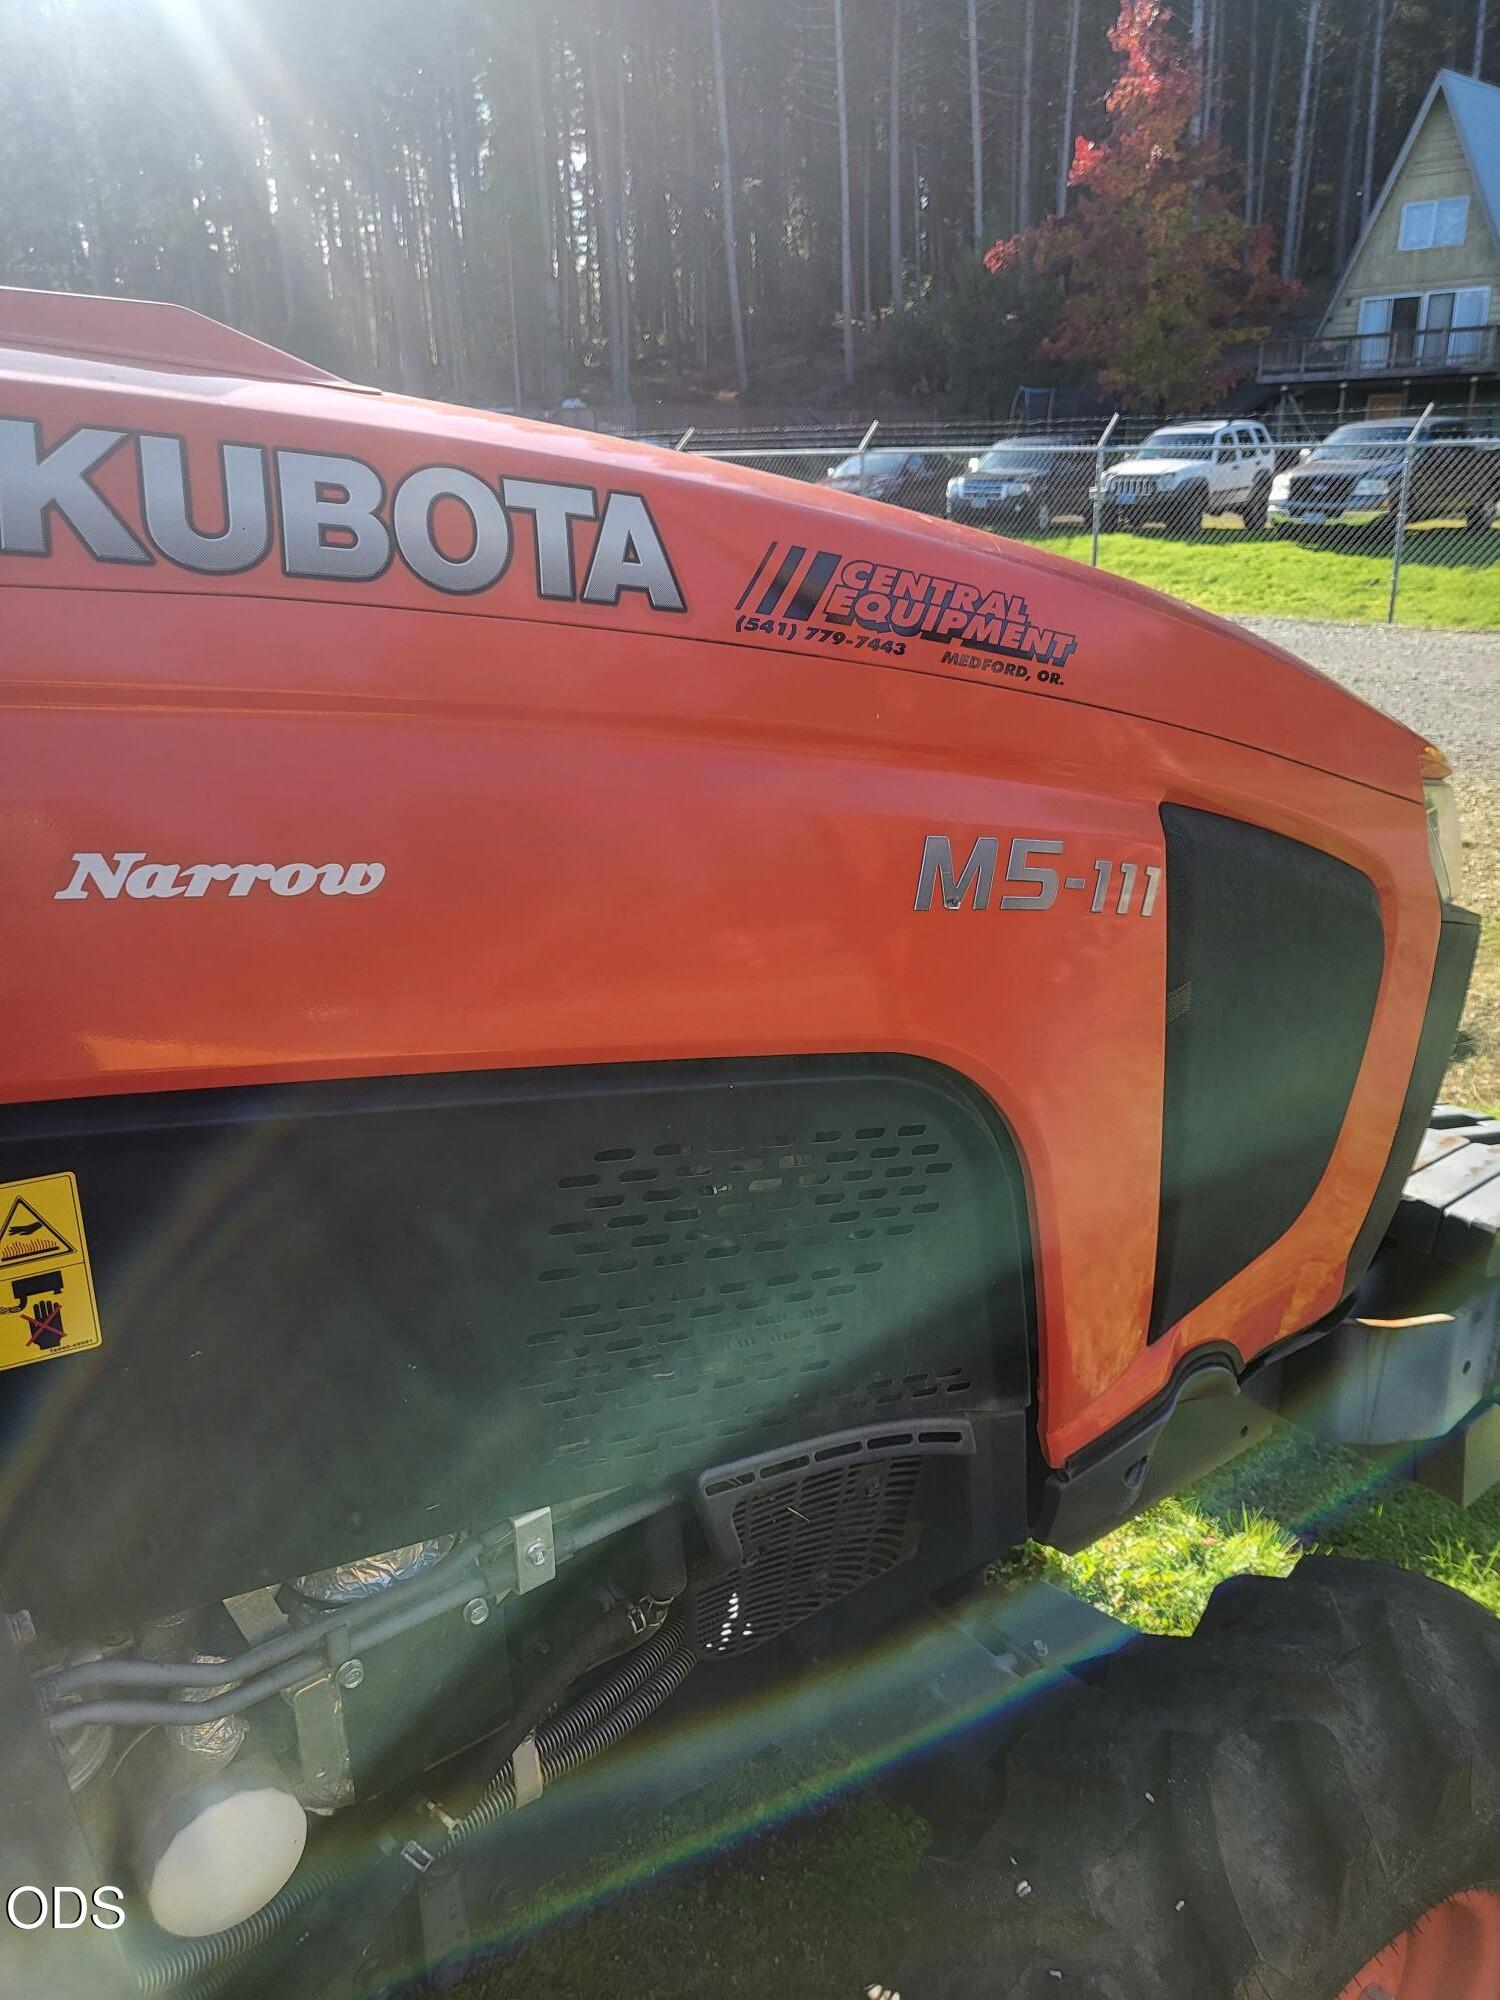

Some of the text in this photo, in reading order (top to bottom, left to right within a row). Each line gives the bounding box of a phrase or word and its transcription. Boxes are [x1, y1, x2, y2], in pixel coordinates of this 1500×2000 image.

[0, 419, 688, 613] KUBOTA
[841, 559, 1029, 622] CENTRAL
[735, 614, 906, 656] (541) 779-7443
[822, 584, 1077, 668] EQUIPMENT
[940, 651, 1064, 685] MEDFORD, OR.
[53, 852, 386, 900] Narrow
[914, 835, 1161, 917] M5-111
